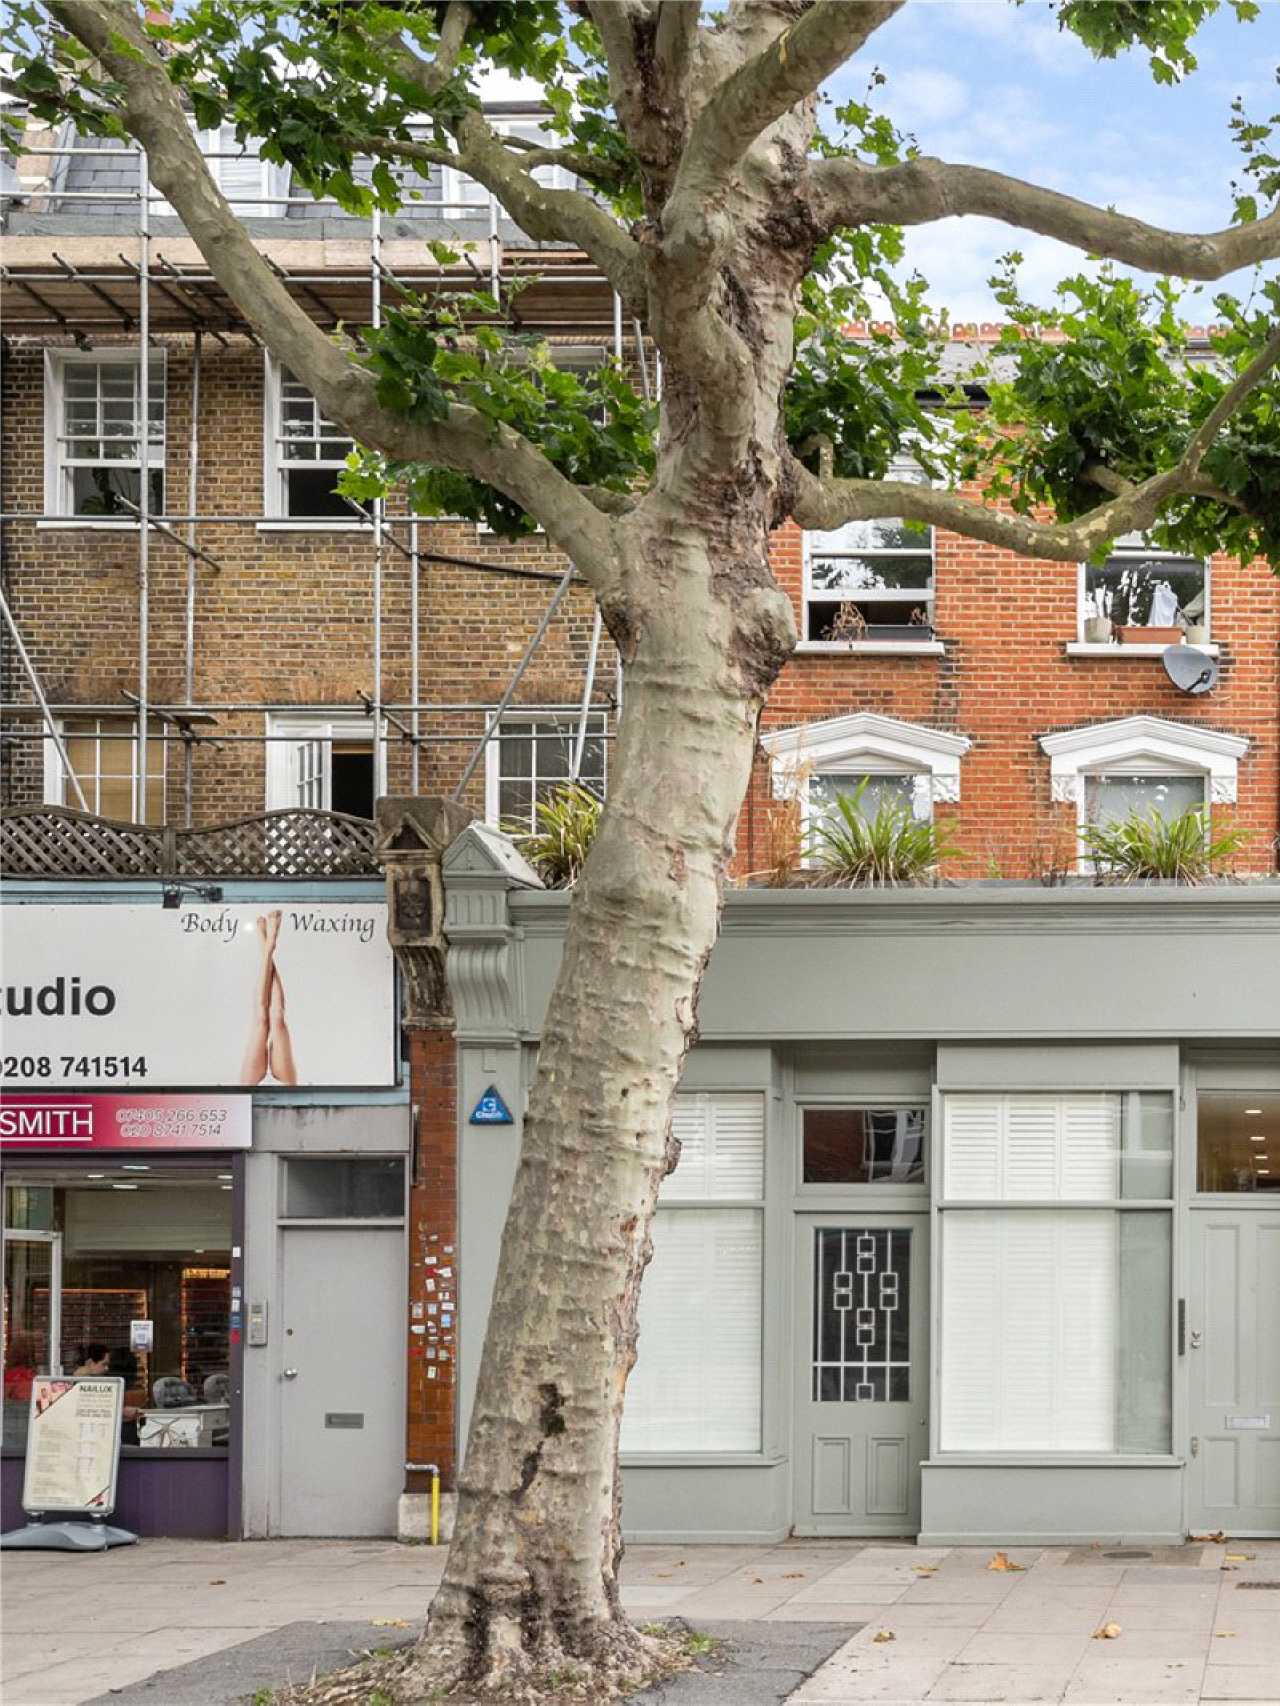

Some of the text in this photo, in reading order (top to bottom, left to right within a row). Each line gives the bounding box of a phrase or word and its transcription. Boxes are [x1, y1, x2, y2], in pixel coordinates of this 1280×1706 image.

[180, 908, 376, 943] Body Waxing
[0, 976, 117, 1016] udio
[0, 1056, 149, 1077] 208 741514
[0, 1110, 93, 1136] SMITH
[199, 1109, 228, 1121] 653
[191, 1124, 221, 1136] 7514
